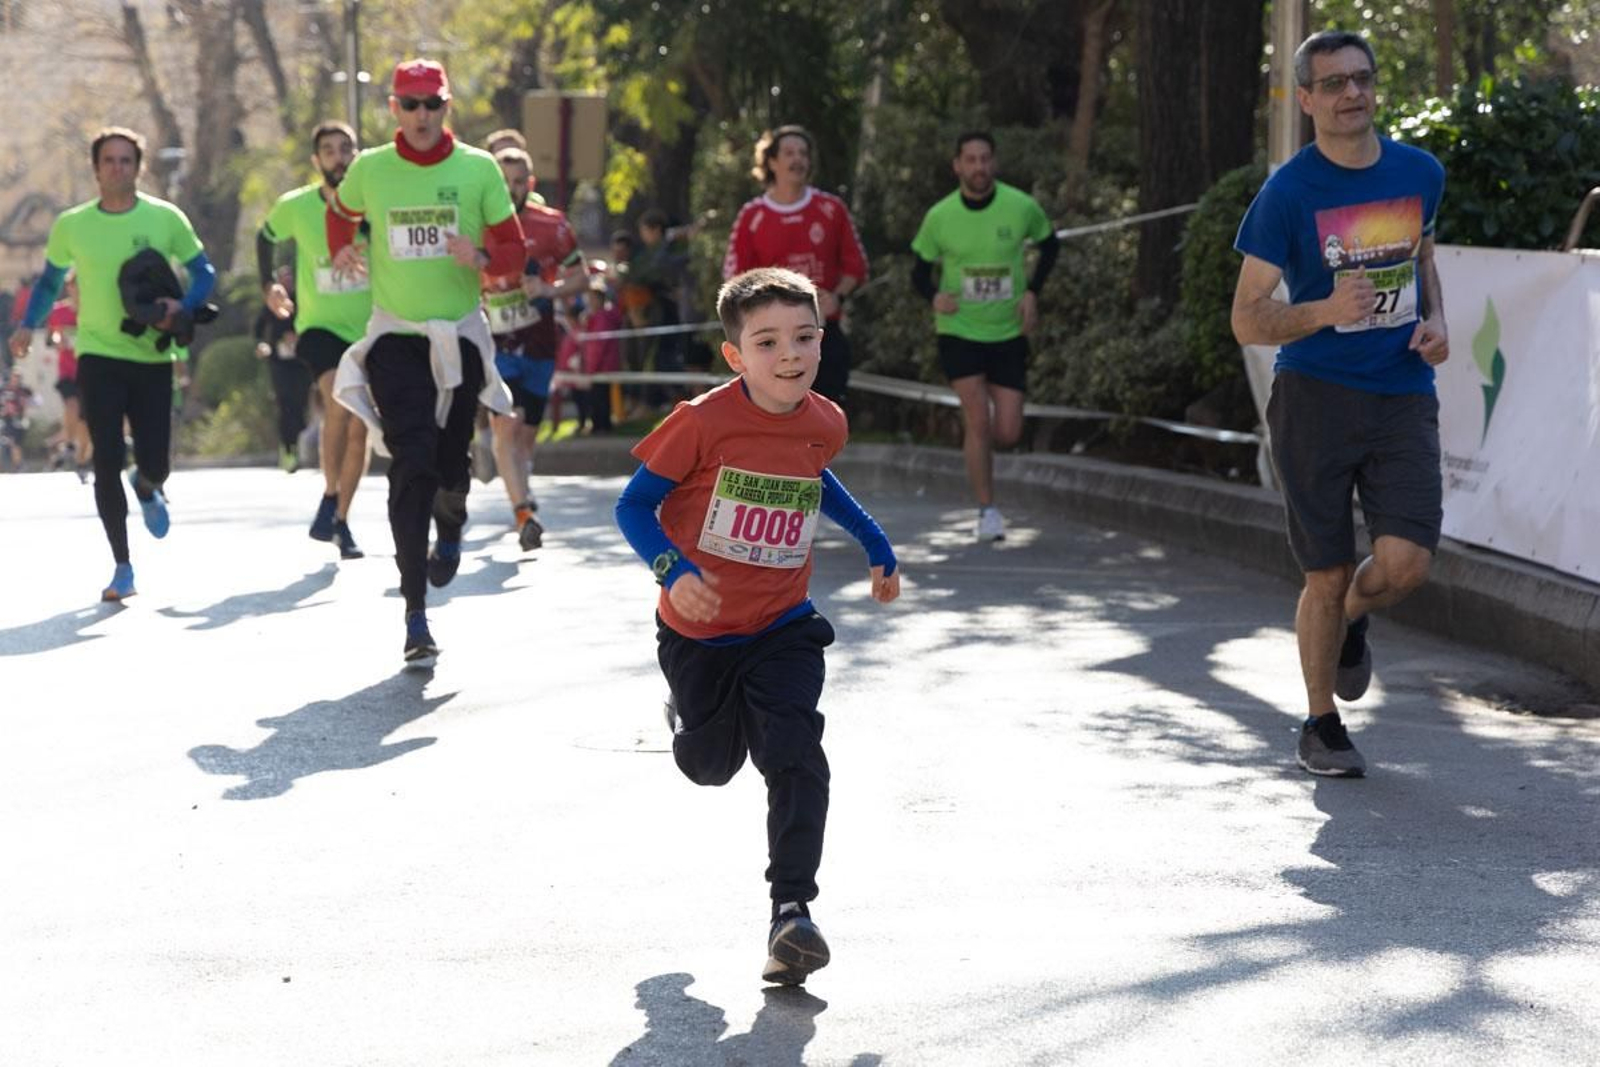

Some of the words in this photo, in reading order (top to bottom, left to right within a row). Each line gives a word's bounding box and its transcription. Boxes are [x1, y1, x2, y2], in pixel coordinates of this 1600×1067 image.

[407, 226, 439, 246] 108
[743, 475, 759, 488] SAN
[760, 478, 781, 491] JUAN
[780, 480, 801, 492] BOSCO
[735, 486, 766, 503] CARRERA
[765, 491, 794, 505] POPULAR
[730, 504, 805, 547] 1008
